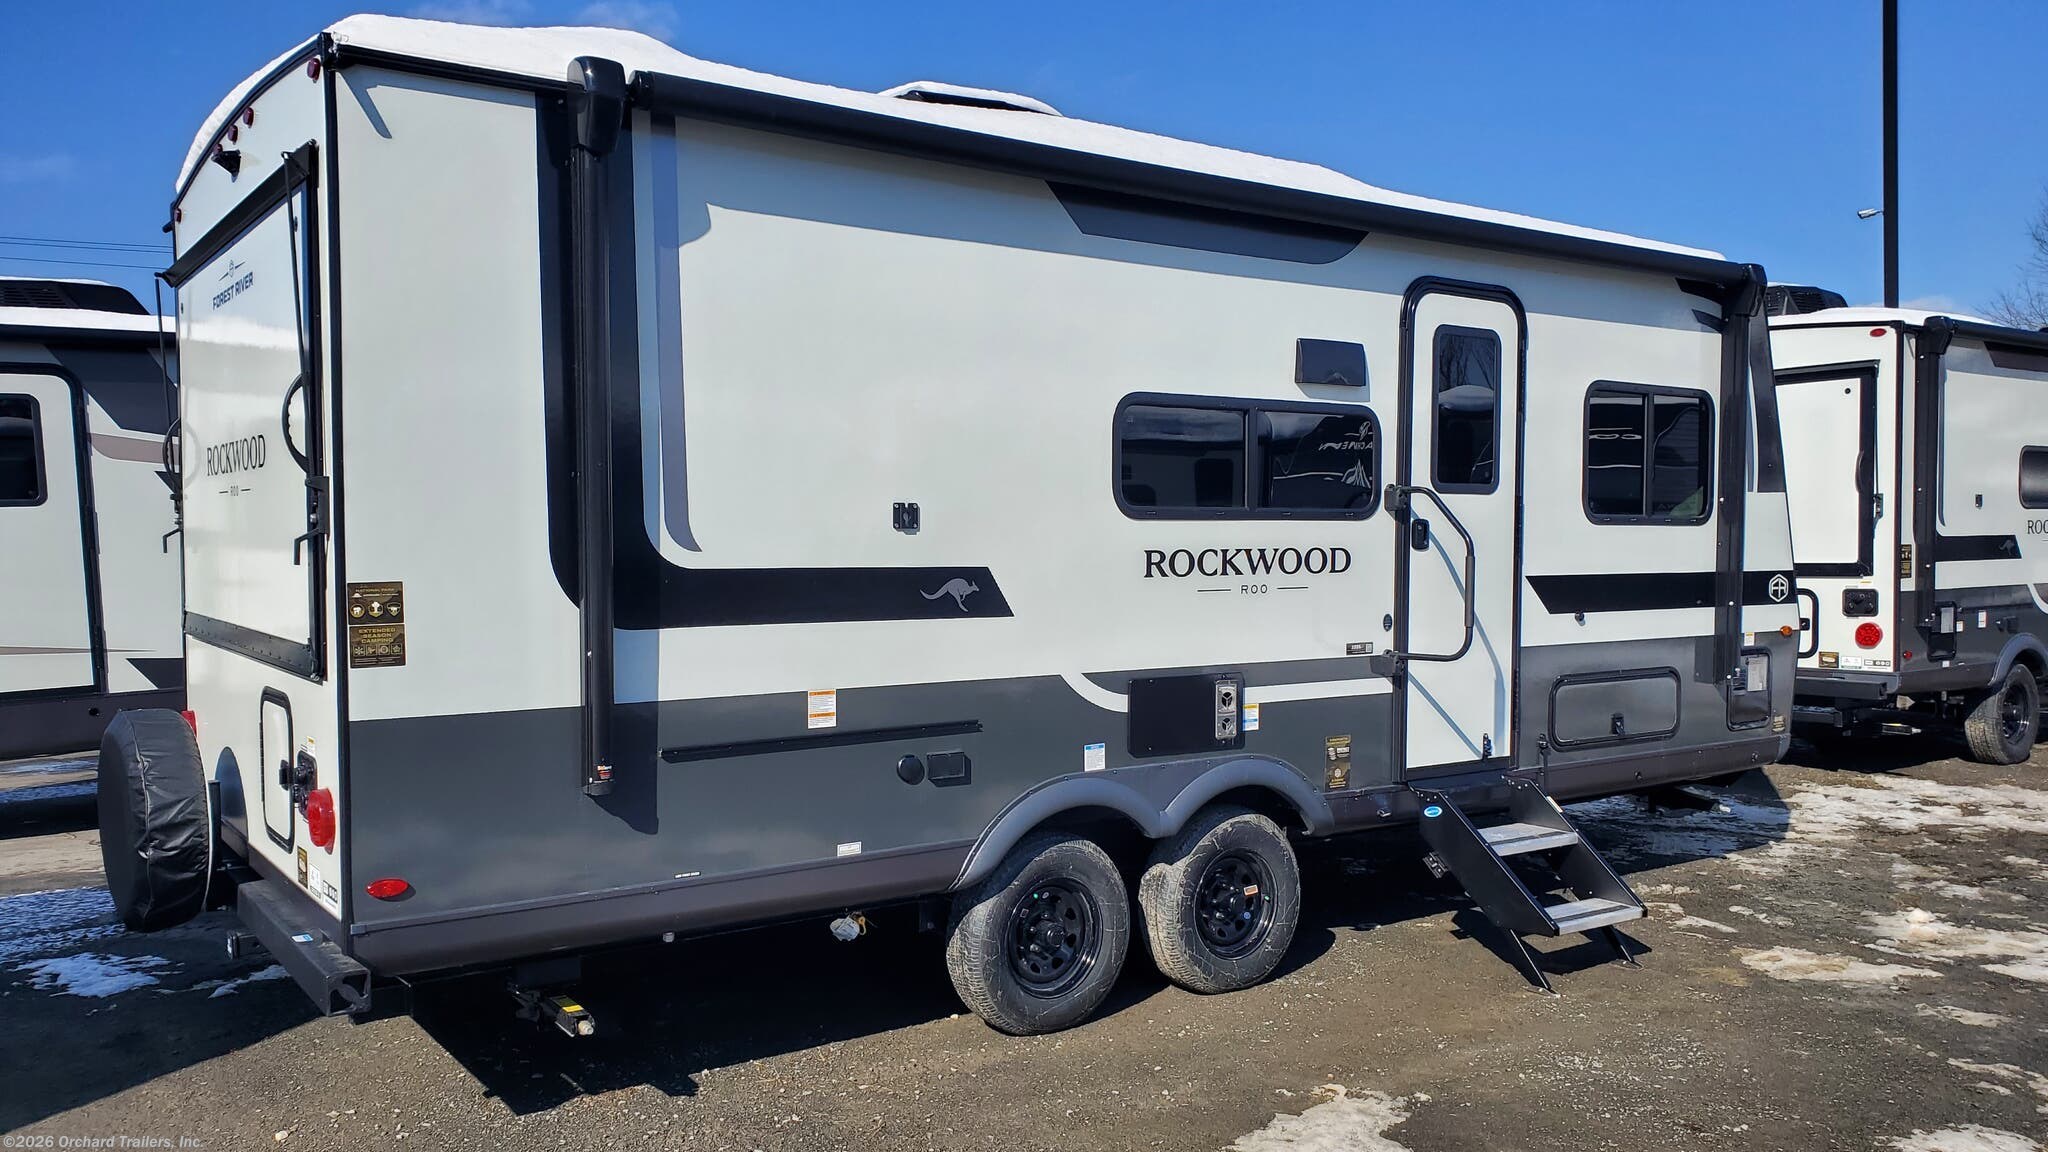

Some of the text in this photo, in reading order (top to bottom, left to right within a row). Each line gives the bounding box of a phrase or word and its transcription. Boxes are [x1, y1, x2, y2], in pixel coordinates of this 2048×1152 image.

[212, 272, 254, 310] FOREST RIVER
[207, 434, 266, 476] ROCKWOOD
[1144, 547, 1352, 578] ROCKWOOD
[1240, 584, 1269, 595] ROO
